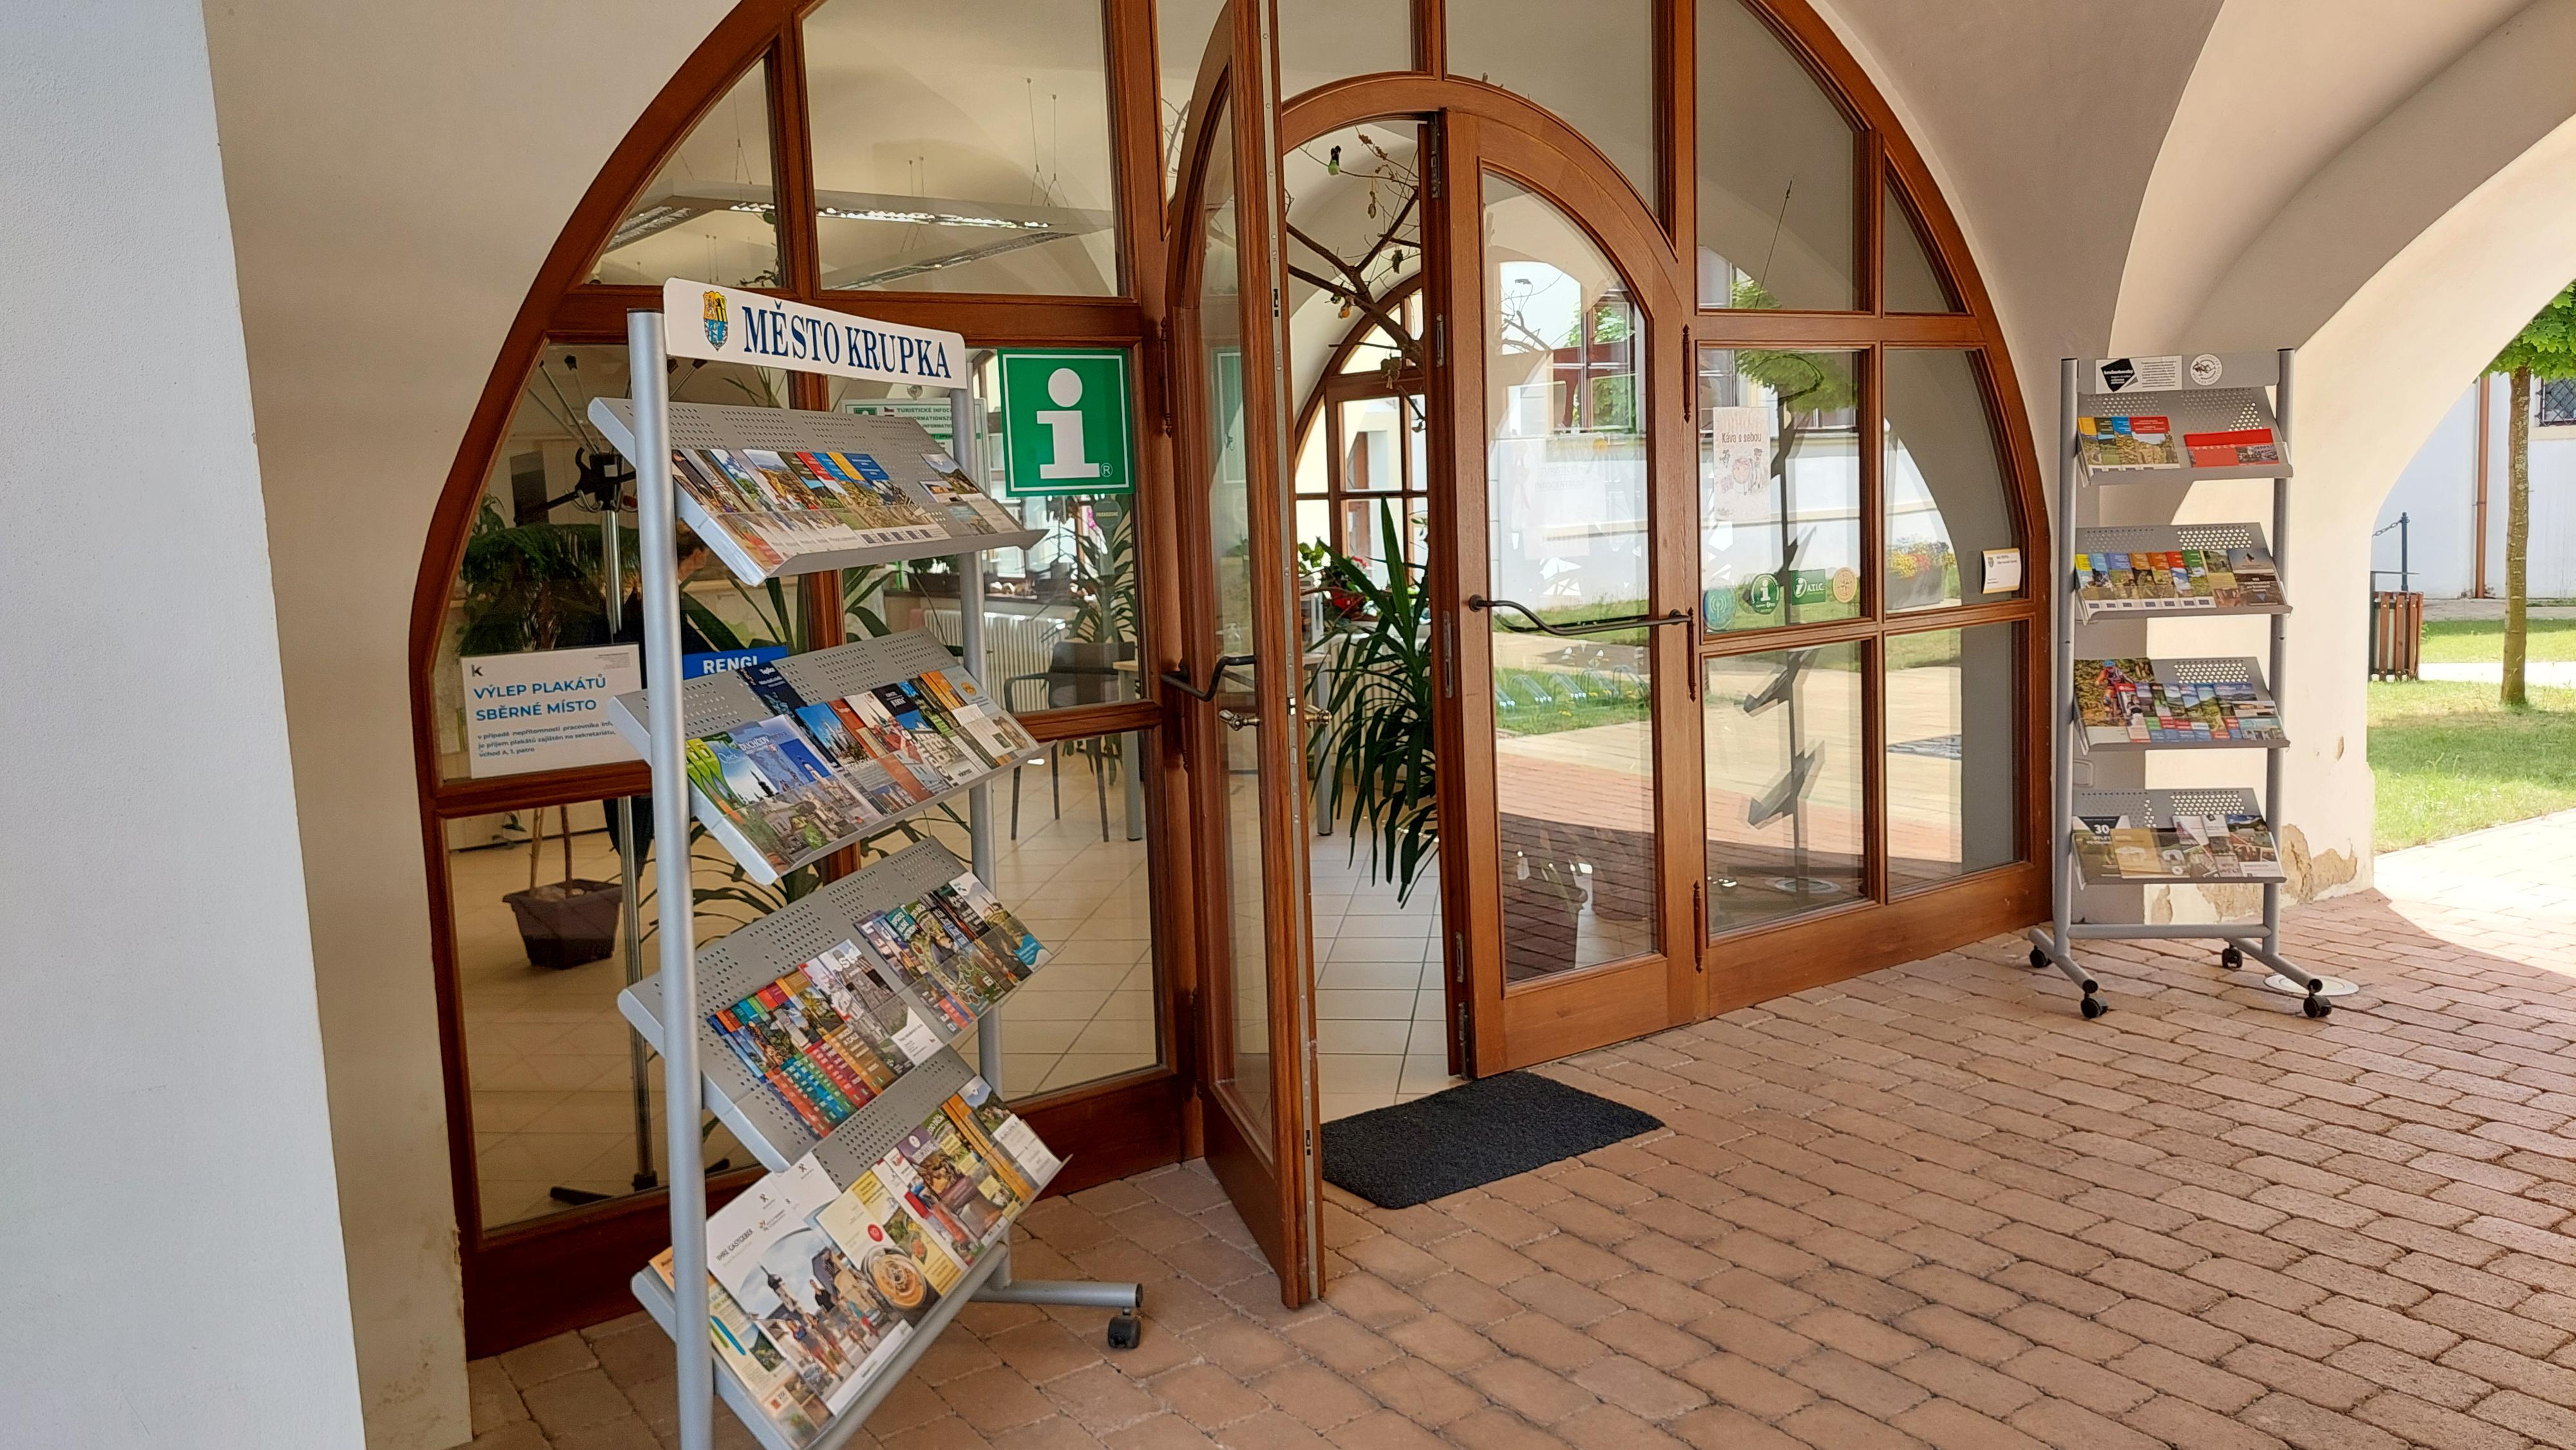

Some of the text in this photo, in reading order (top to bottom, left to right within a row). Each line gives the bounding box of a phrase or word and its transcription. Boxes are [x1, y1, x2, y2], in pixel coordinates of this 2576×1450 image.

[742, 299, 952, 379] MĚSTO KRUPKA
[1721, 431, 1737, 444] Káva
[1743, 432, 1762, 443] sebou
[474, 673, 607, 699] VÝLEP PLAKÁTŮ
[476, 699, 597, 721] SBĚRNÉ MÍSTO
[516, 747, 535, 756] patro
[2093, 824, 2110, 834] 30
